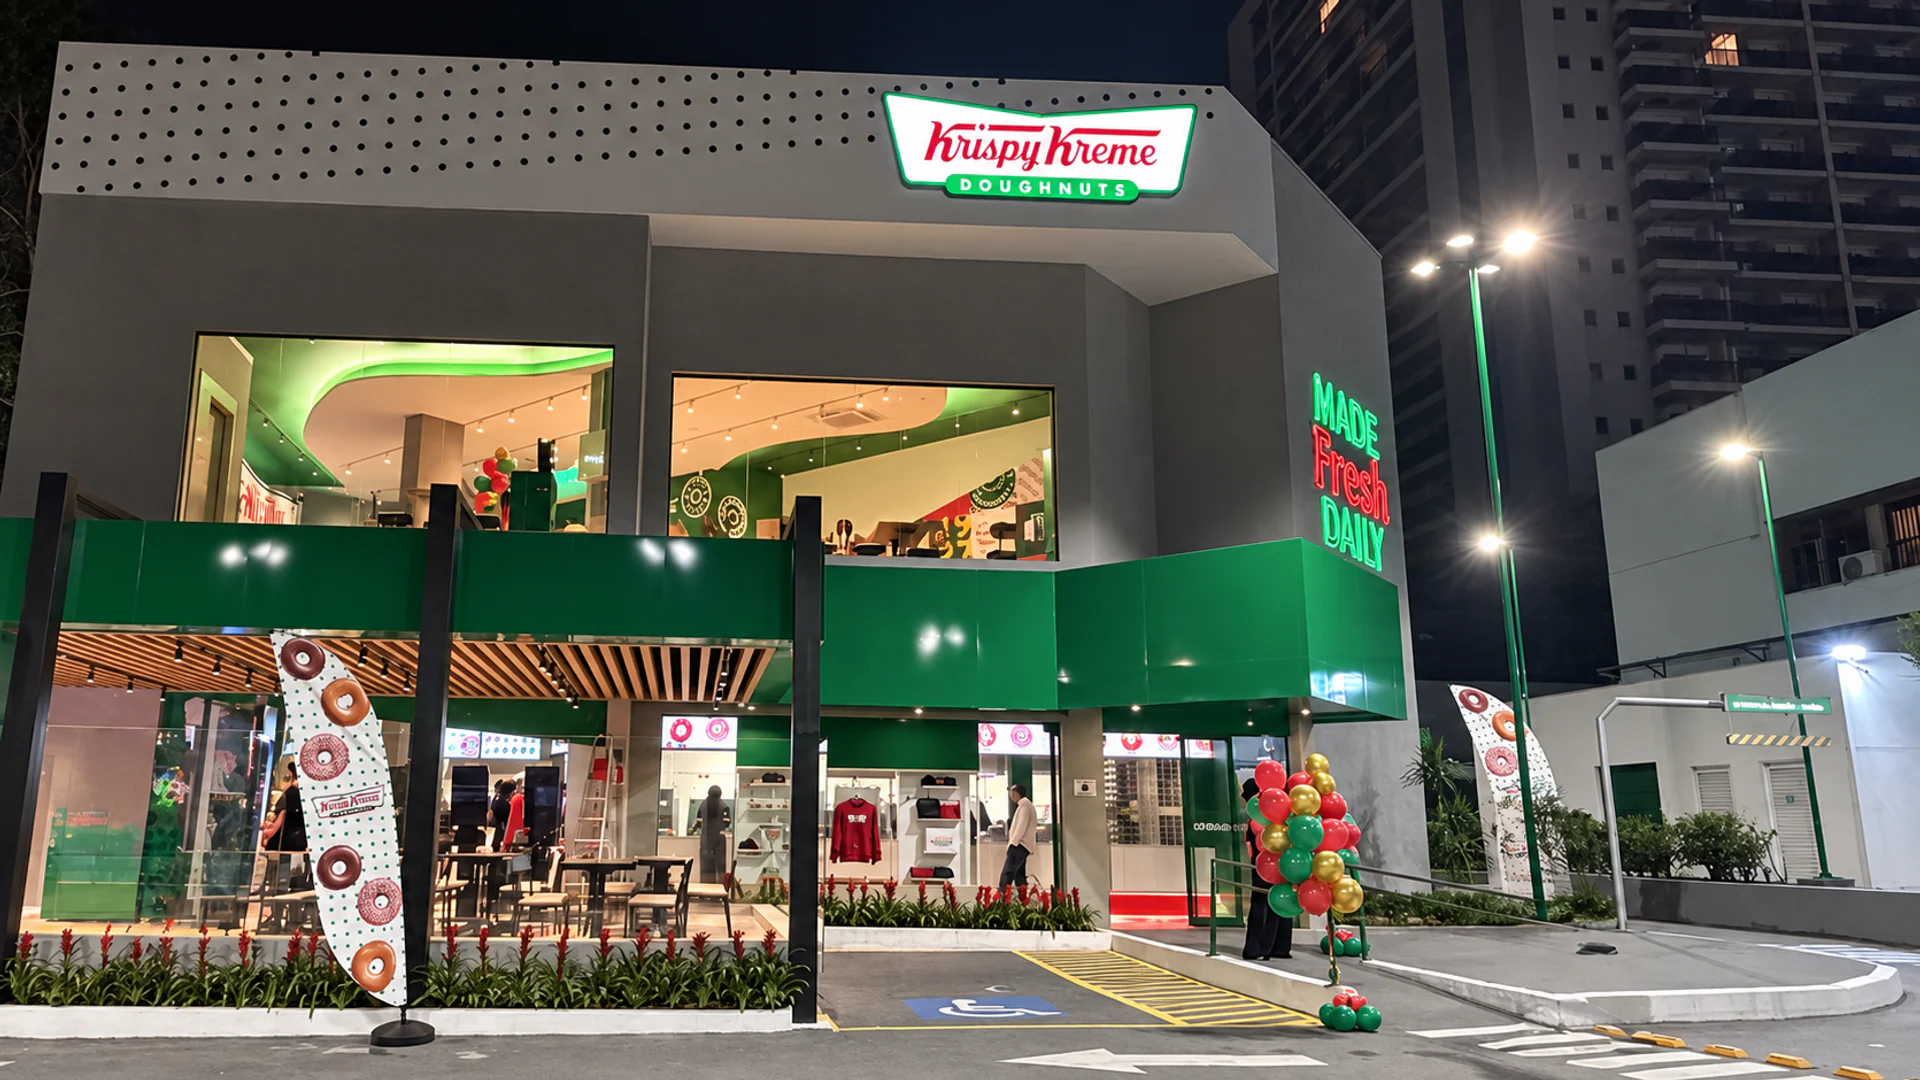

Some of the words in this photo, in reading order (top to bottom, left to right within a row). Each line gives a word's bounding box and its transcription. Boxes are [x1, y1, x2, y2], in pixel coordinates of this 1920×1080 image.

[924, 120, 1045, 172] Krispy
[1045, 125, 1161, 167] Kreme
[960, 178, 1125, 197] DOUGHNUTS
[1312, 372, 1381, 461] MADE
[1312, 424, 1390, 526] Fresh
[1320, 494, 1384, 572] DAILY
